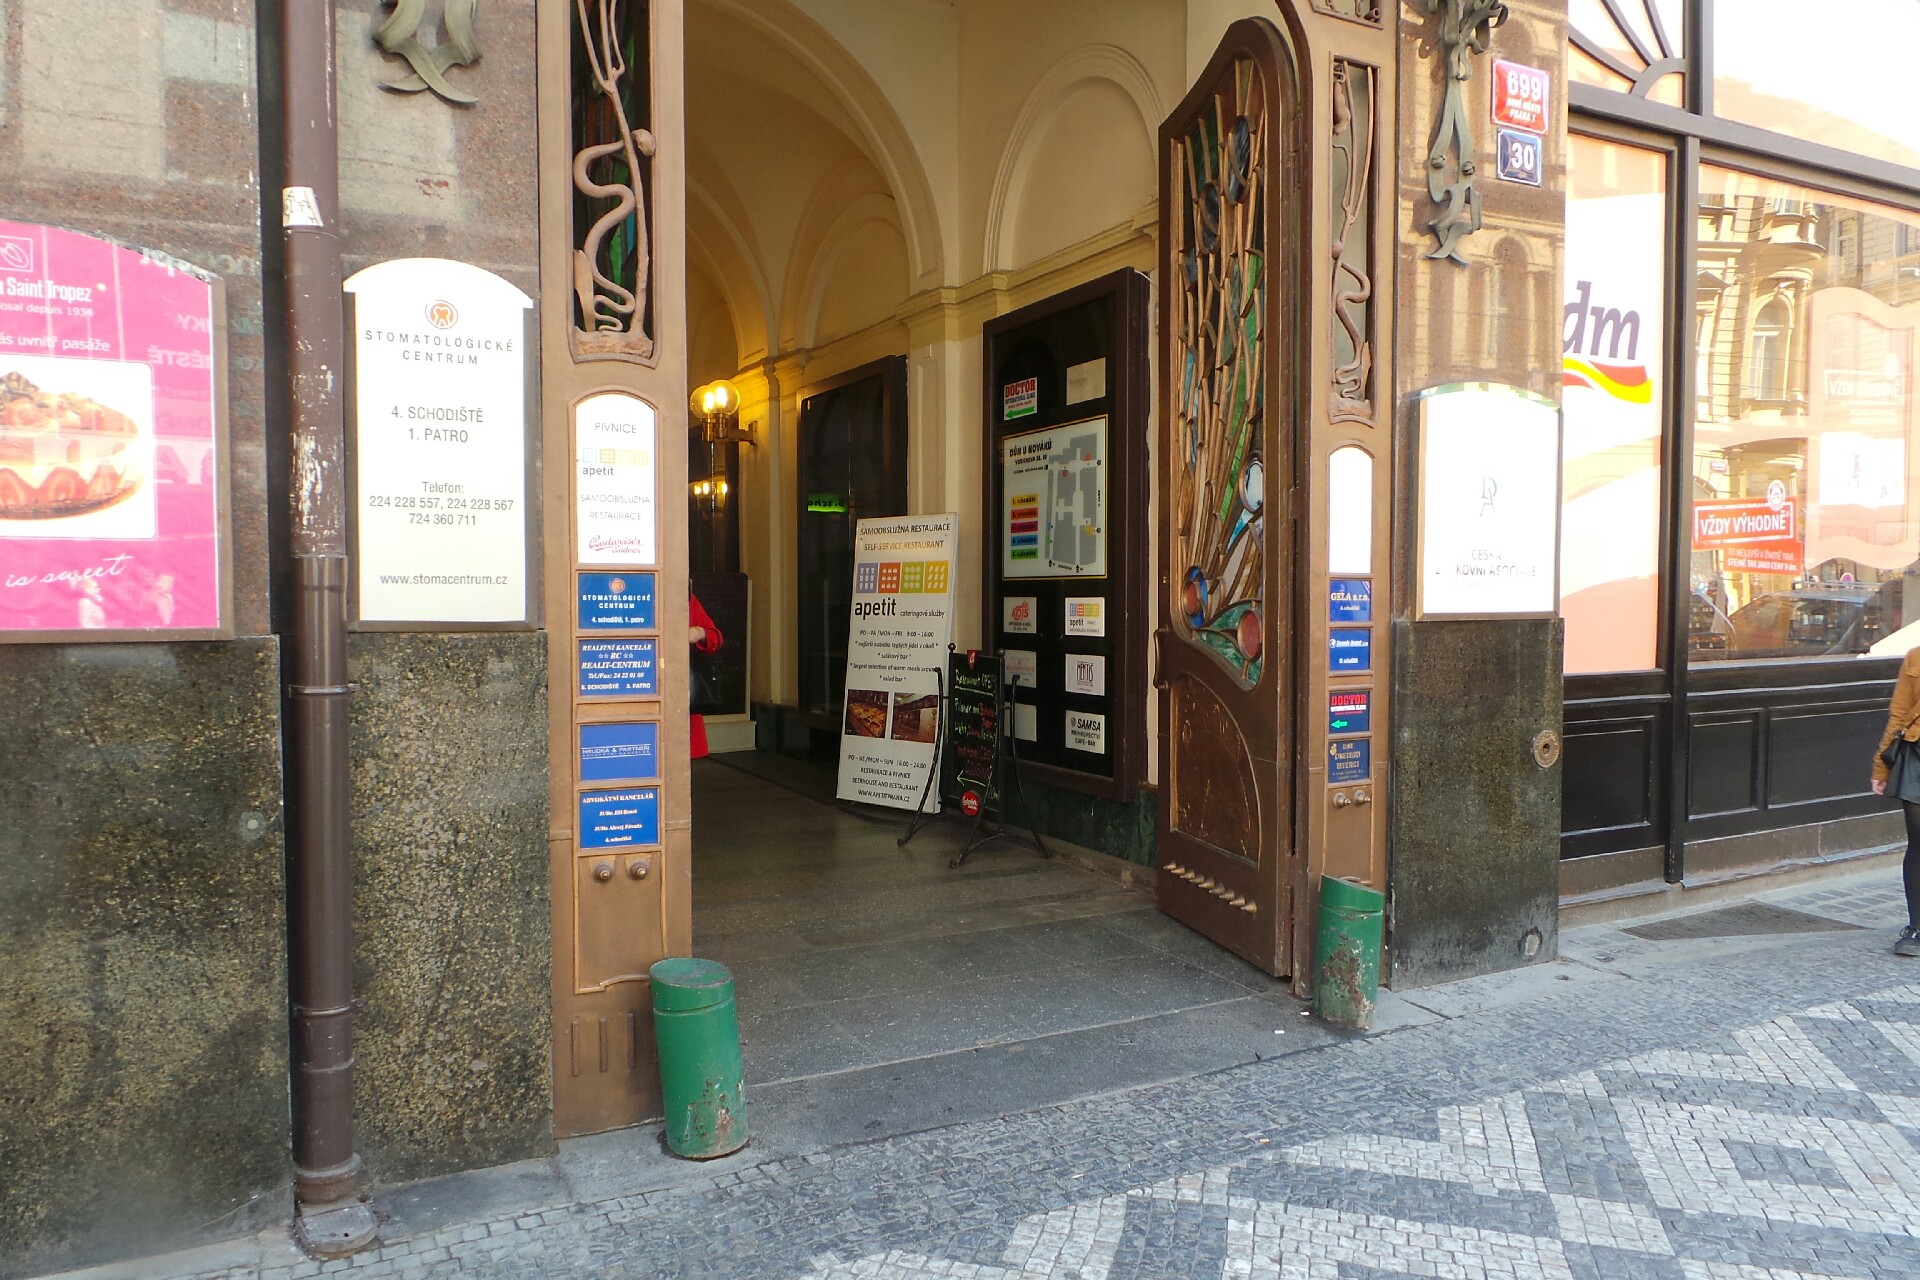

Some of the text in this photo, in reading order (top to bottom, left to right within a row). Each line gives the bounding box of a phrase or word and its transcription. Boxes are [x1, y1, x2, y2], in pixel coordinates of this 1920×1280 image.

[1507, 70, 1542, 100] 699
[1512, 142, 1534, 170] 30
[7, 277, 43, 298] Saint
[46, 280, 92, 303] Tropez
[26, 304, 62, 315] depuis
[67, 307, 93, 317] 1934
[1563, 280, 1640, 360] dm
[62, 337, 110, 351] pasáže
[365, 330, 514, 352] STOMATOLOGICKÉ
[402, 350, 479, 365] CENTRUM
[1005, 379, 1036, 398] DOCTOR
[392, 406, 484, 423] 4. SCHODIŠTĚ
[594, 422, 637, 434] PIVNICE
[408, 428, 469, 443] 1. PATRO
[1010, 438, 1052, 457] DŮM U NOVÁKŮ
[582, 466, 614, 477] apetit
[422, 482, 464, 494] Telefon:
[370, 496, 514, 511] 224 228 557, 224 228 567
[409, 513, 476, 526] 724 360 711
[589, 510, 642, 520] RESTAURACE
[1700, 510, 1786, 535] VŽDY VÝHODNĚ
[860, 523, 950, 536] SAMOOBSLUŽNÁ RESTAURACE
[904, 540, 944, 550] RESTAURANT
[6, 553, 134, 587] is sweet
[380, 573, 508, 586] www.stomacentrum.cz
[1331, 592, 1351, 601] GELA
[854, 598, 945, 620] apetit cateringové služby
[1070, 619, 1084, 628] apetit
[581, 661, 650, 669] REALIT-CENTRUM
[1331, 694, 1367, 706] DOCTOR
[1077, 719, 1100, 732] SAMSA
[861, 767, 887, 775] RESTAURACE
[852, 778, 918, 791] BEERHOUSE AND RESTAURANT
[582, 795, 619, 804] ADVOKÁTNÍ
